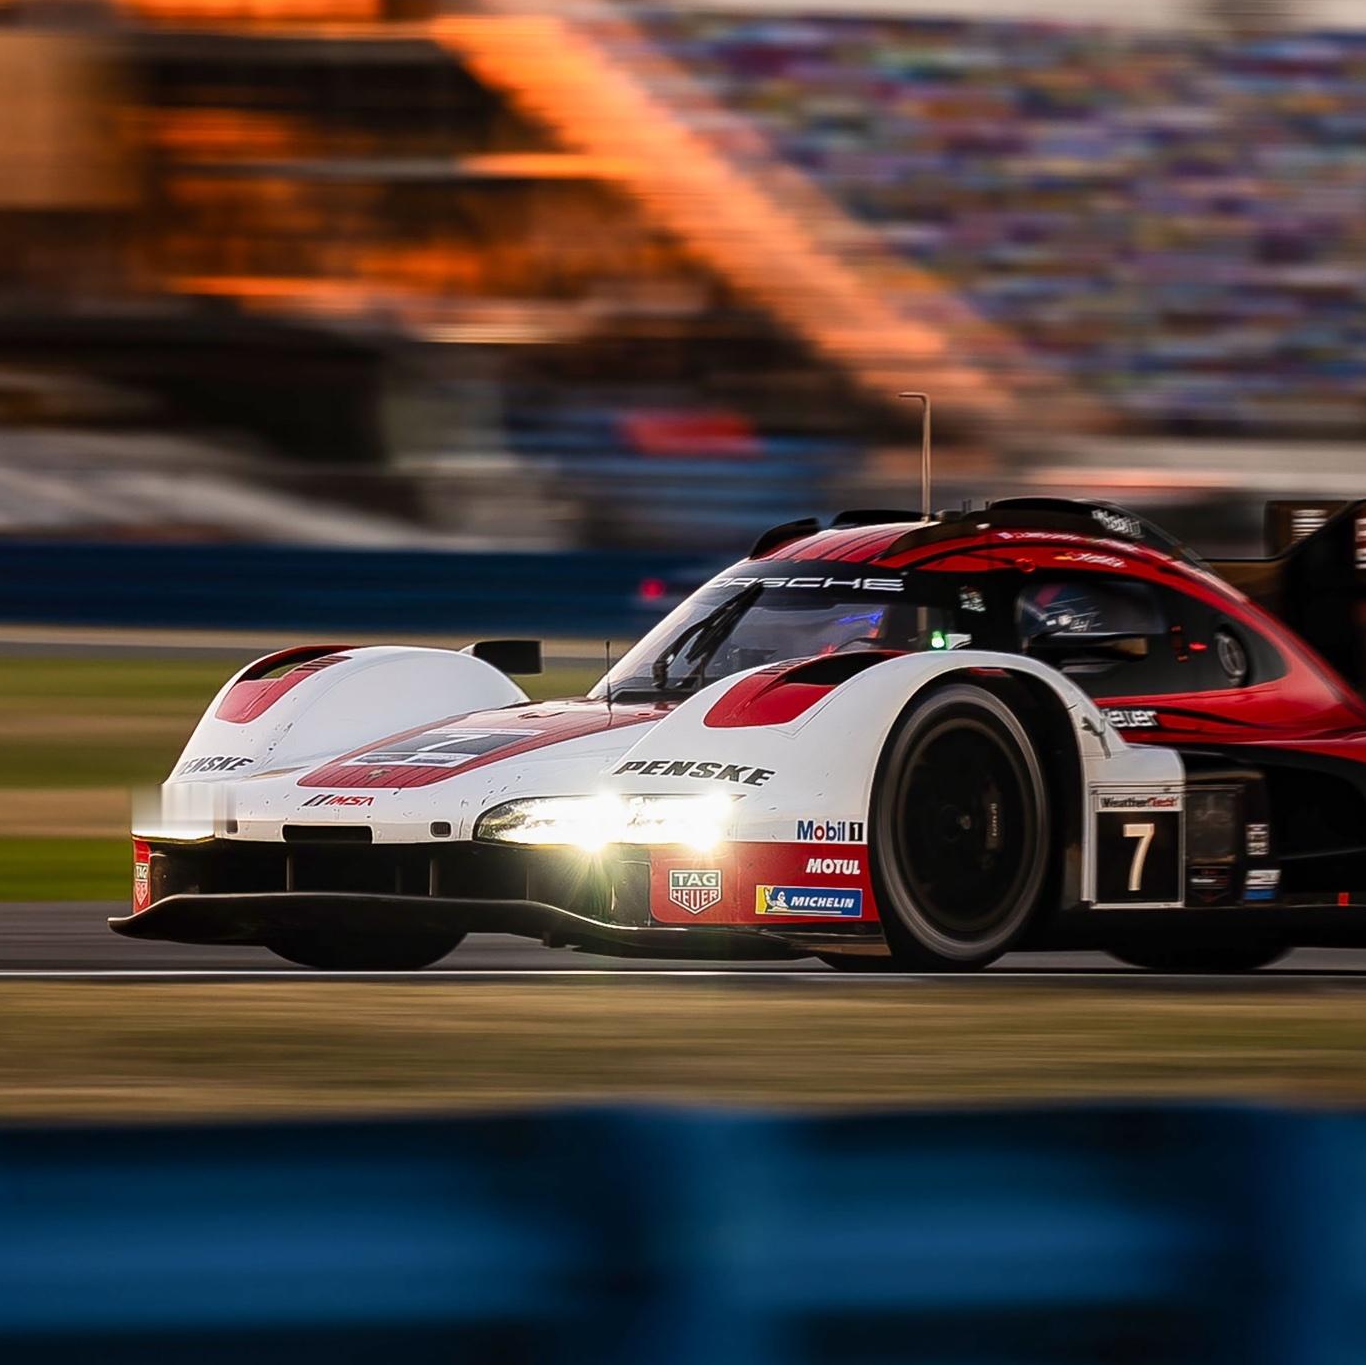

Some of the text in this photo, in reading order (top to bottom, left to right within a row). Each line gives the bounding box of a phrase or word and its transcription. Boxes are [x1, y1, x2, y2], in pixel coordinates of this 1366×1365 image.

[705, 577, 905, 592] ORSCHE
[613, 760, 776, 787] PENSKE
[325, 795, 376, 806] IMSA
[797, 820, 862, 842] Mobil 1
[1123, 823, 1155, 891] 7
[805, 858, 861, 875] MOTUL
[674, 873, 718, 886] TAG
[671, 889, 719, 909] HEUER
[790, 895, 855, 909] MICHELIN
